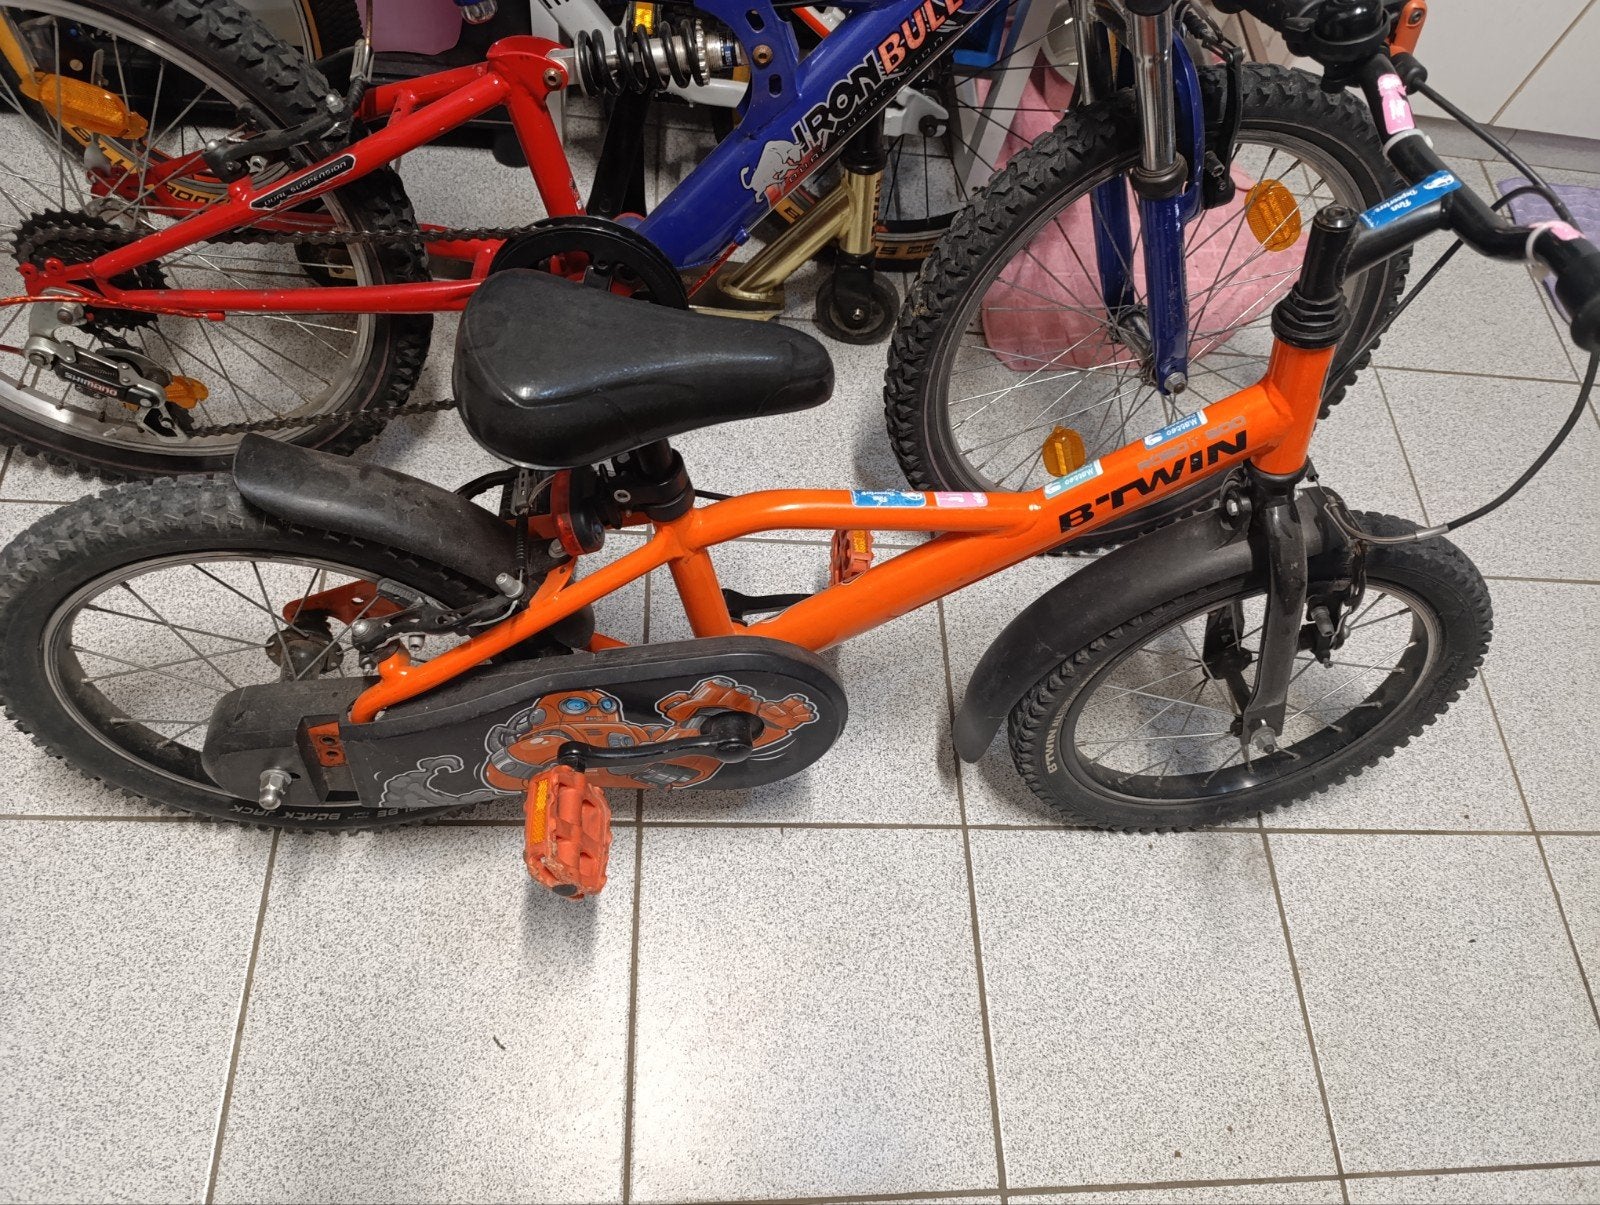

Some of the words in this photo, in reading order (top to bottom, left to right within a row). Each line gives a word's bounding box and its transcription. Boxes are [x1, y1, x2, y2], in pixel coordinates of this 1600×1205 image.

[264, 192, 287, 206] DUAL
[290, 161, 347, 192] SUSPENSION
[64, 371, 118, 397] SHIMANO
[1166, 416, 1199, 436] Matteo
[1064, 465, 1095, 486] Matteo
